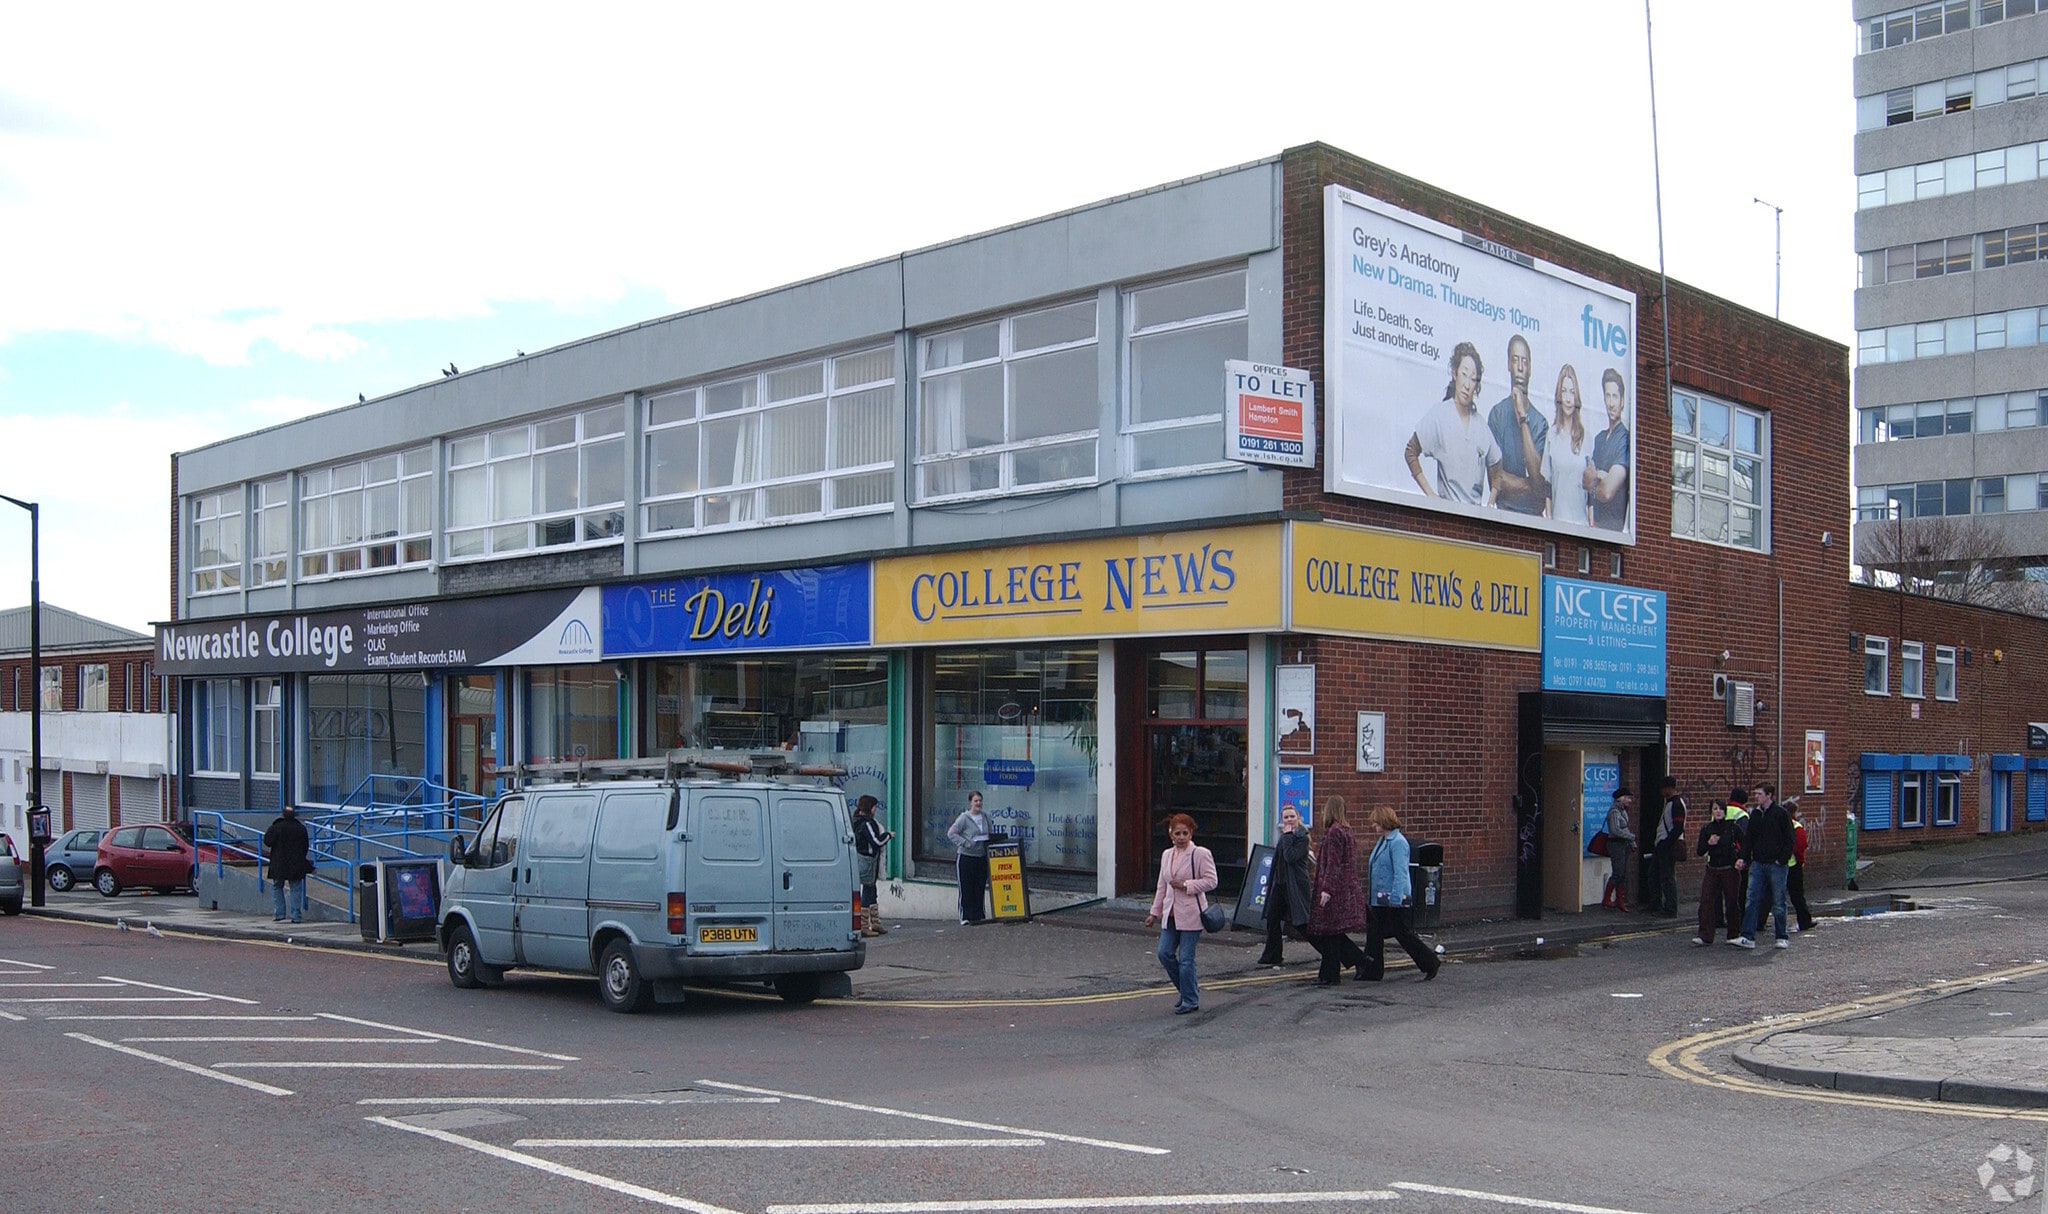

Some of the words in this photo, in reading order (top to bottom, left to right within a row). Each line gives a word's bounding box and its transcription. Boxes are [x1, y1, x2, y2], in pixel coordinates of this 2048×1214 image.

[1353, 227, 1397, 258] Grey's
[1400, 244, 1460, 283] Anatomy
[1482, 240, 1517, 260] MAIDEN
[1353, 254, 1385, 281] New
[1388, 266, 1437, 299] Drama.
[1440, 283, 1506, 322] Thursdays
[1509, 307, 1540, 332] 10pm
[1353, 299, 1376, 319] Life.
[1378, 307, 1412, 330] Death.
[1414, 318, 1434, 336] Sex
[1581, 304, 1627, 357] five
[1352, 320, 1376, 340] Just
[1378, 329, 1419, 353] another
[1420, 341, 1440, 360] day.
[1253, 364, 1288, 377] OFFICES
[1235, 374, 1260, 391] TO
[1272, 379, 1307, 398] LET
[1249, 402, 1276, 414] Lambert
[1278, 406, 1298, 417] Smith
[1249, 413, 1278, 424] Hampton
[1241, 437, 1260, 447] 0191
[1263, 440, 1277, 450] 261
[1280, 442, 1301, 453] 1300
[911, 560, 1082, 623] COLLEGE
[1306, 557, 1400, 602] COLLEGE
[1471, 580, 1484, 611] &
[1490, 582, 1529, 617] DELI
[651, 588, 676, 604] THE
[367, 606, 406, 620] International
[408, 604, 429, 616] Office
[685, 578, 776, 639] Deli
[1555, 585, 1591, 617] NC
[1601, 591, 1658, 625] LETS
[367, 622, 398, 637] Marketing
[400, 620, 420, 633] Office
[1555, 615, 1598, 630] PROPERTY
[1601, 622, 1657, 636] MANAGEMENT
[163, 621, 259, 661] Newcastle
[266, 616, 354, 667] College
[367, 638, 386, 651] OLAS
[1587, 635, 1593, 645] &
[1597, 636, 1627, 649] LETTING
[1594, 768, 1617, 780] LETS
[1048, 813, 1063, 823] Hot
[1065, 814, 1072, 823] &
[1075, 814, 1095, 824] Cold
[1010, 825, 1035, 838] DELI
[989, 848, 1002, 857] The
[1004, 847, 1018, 856] Deli
[734, 929, 756, 940] UTN
